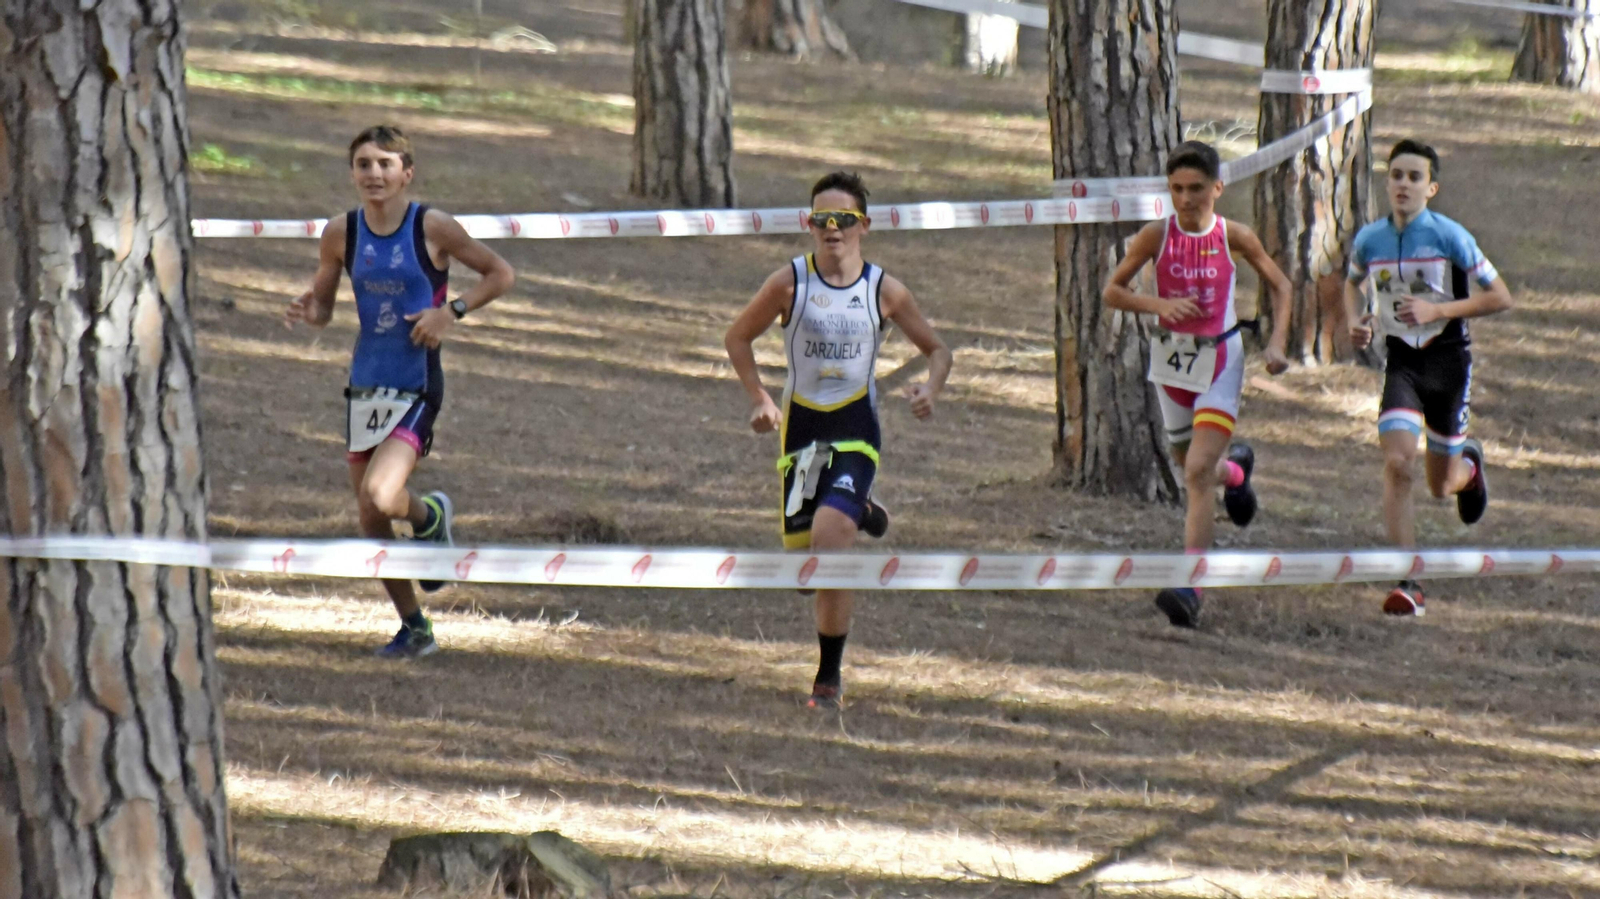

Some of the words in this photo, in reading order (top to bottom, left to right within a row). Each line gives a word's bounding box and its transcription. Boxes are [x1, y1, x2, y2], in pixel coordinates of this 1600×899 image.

[1170, 263, 1218, 279] Curro
[804, 341, 862, 359] ZARZUELA
[1167, 351, 1199, 375] 47
